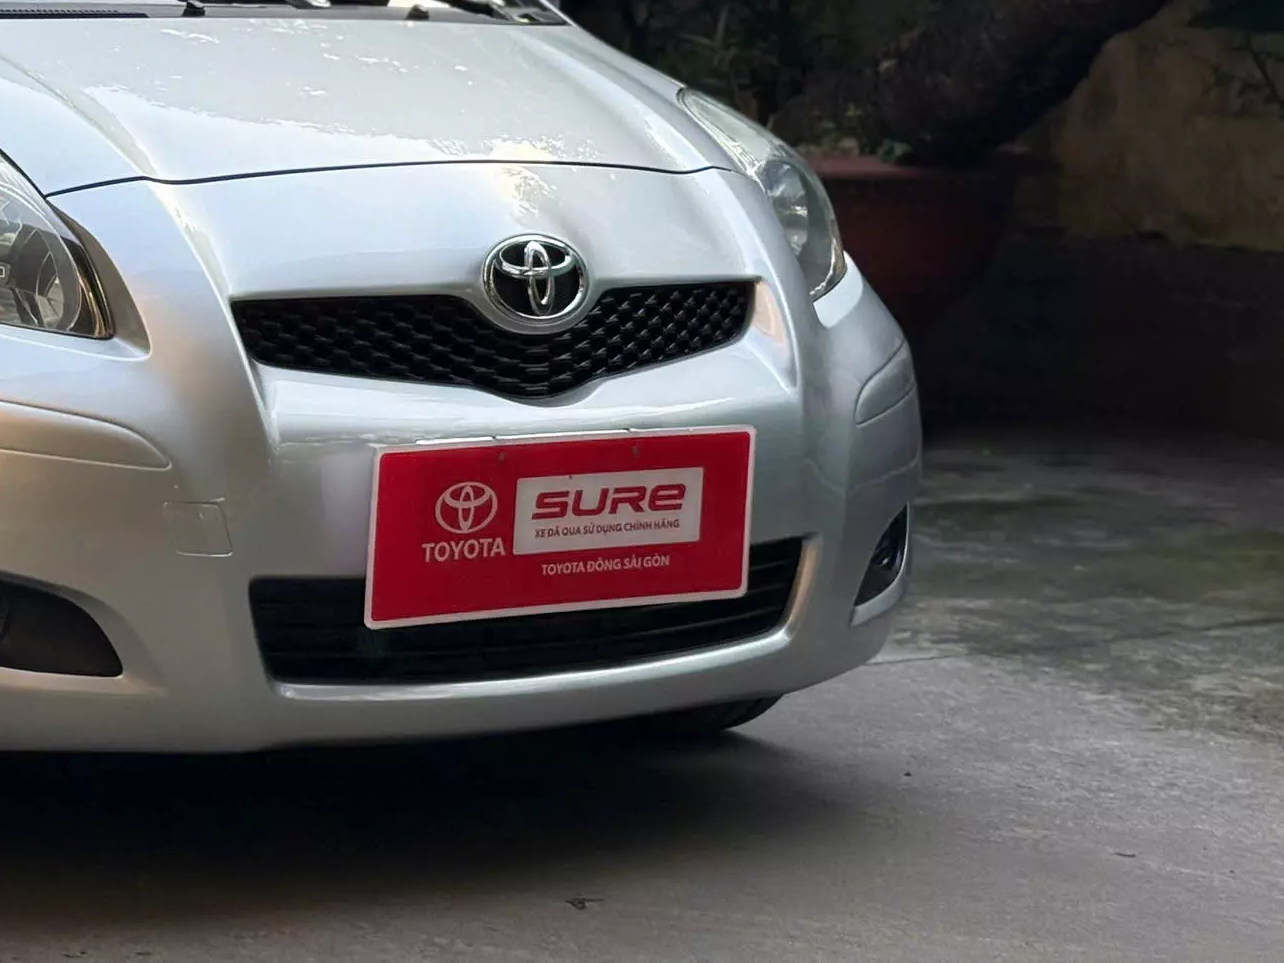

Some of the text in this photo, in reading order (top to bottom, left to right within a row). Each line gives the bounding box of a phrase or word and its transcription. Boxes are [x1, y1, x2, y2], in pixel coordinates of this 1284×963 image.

[534, 527, 547, 538] XE
[562, 525, 582, 537] QUA
[596, 523, 622, 535] DỤNG
[624, 519, 653, 531] CHÍNH
[421, 536, 506, 563] TOYOTA
[541, 561, 585, 576] TOYOTA
[586, 557, 622, 573] ĐÔNG
[643, 552, 670, 568] GÒN
